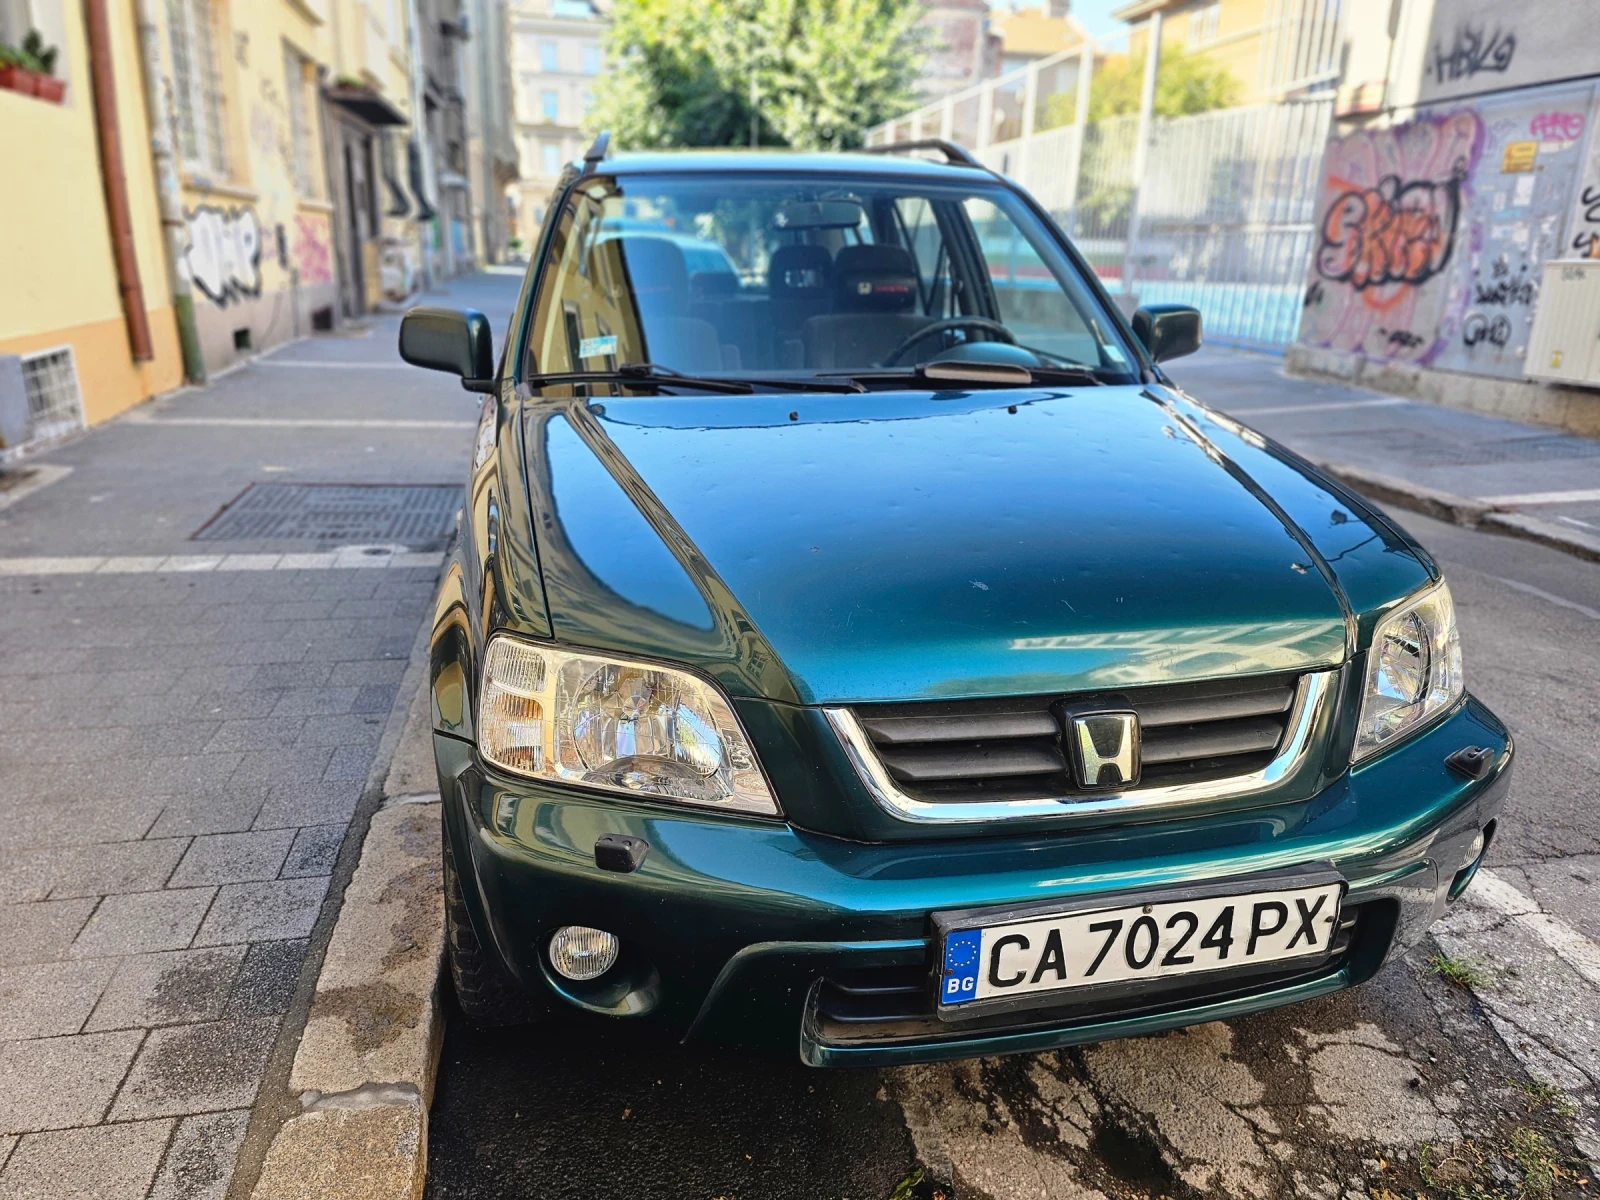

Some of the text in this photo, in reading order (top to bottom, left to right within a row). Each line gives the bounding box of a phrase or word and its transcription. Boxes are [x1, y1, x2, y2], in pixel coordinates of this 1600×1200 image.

[988, 894, 1329, 988] CA 7024 PX
[947, 976, 975, 994] BG
